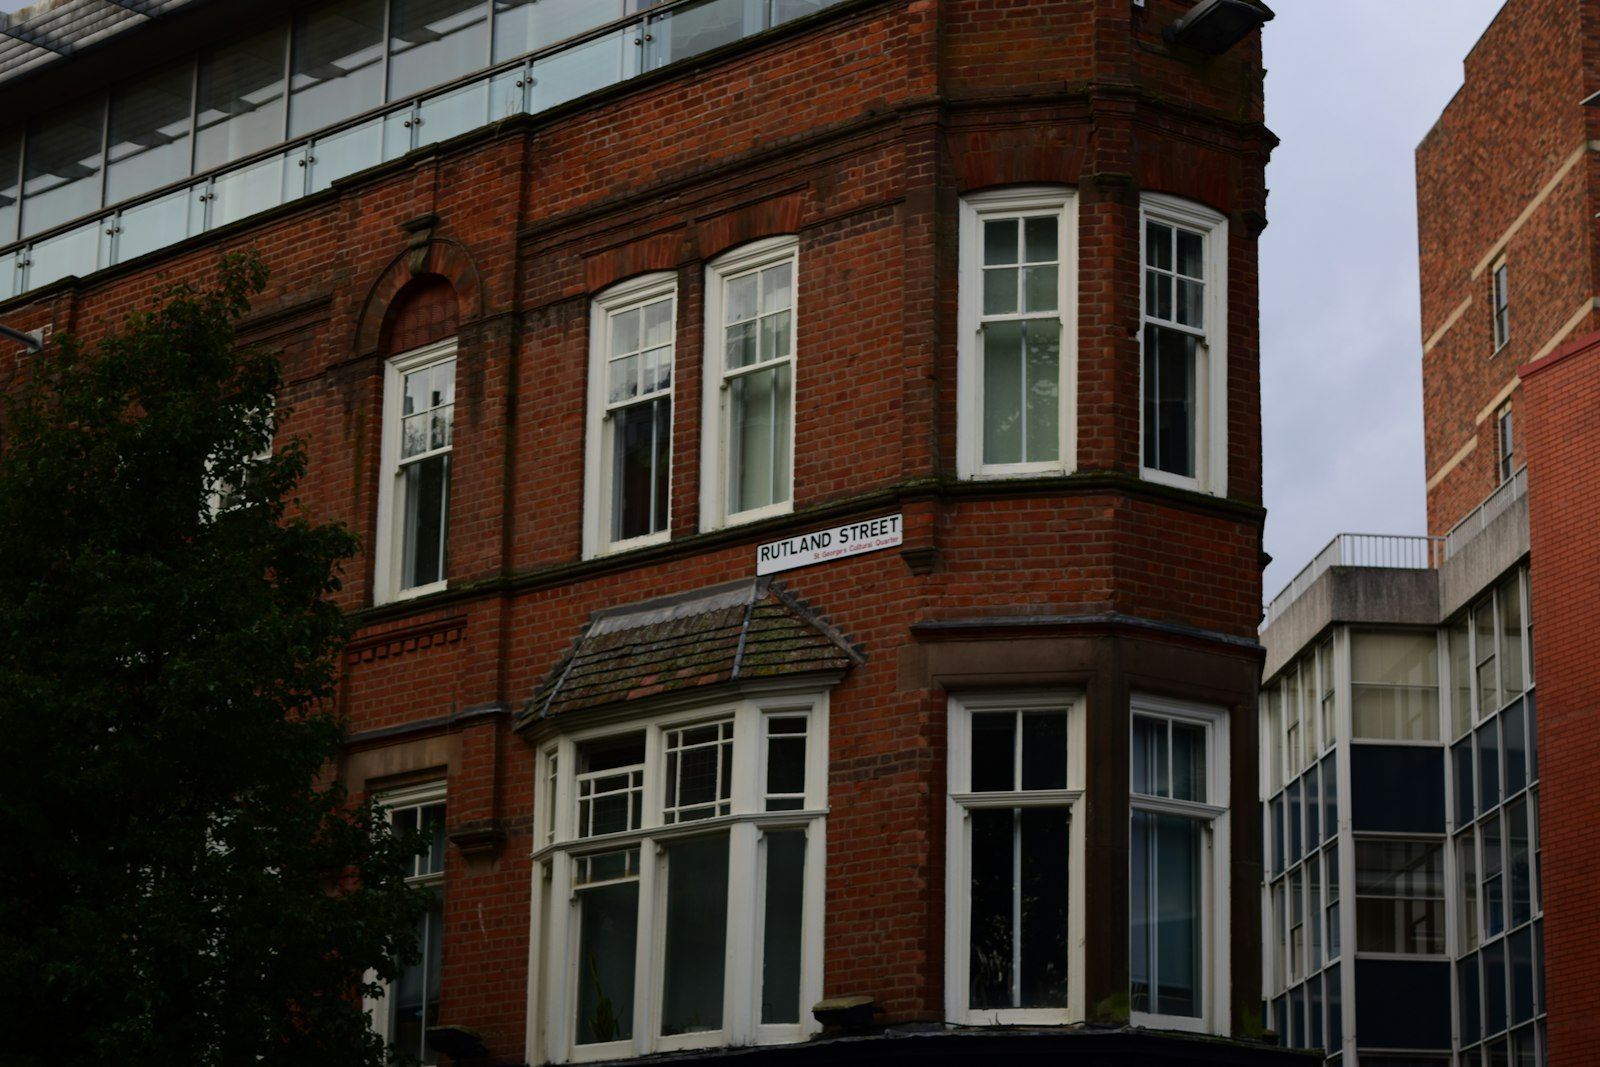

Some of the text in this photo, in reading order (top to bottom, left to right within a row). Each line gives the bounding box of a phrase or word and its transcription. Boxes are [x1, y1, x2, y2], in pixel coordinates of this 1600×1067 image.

[761, 517, 899, 562] RUTLAND STREET
[813, 552, 820, 560] St
[849, 542, 873, 552] Cultural
[875, 536, 899, 547] Quarter
